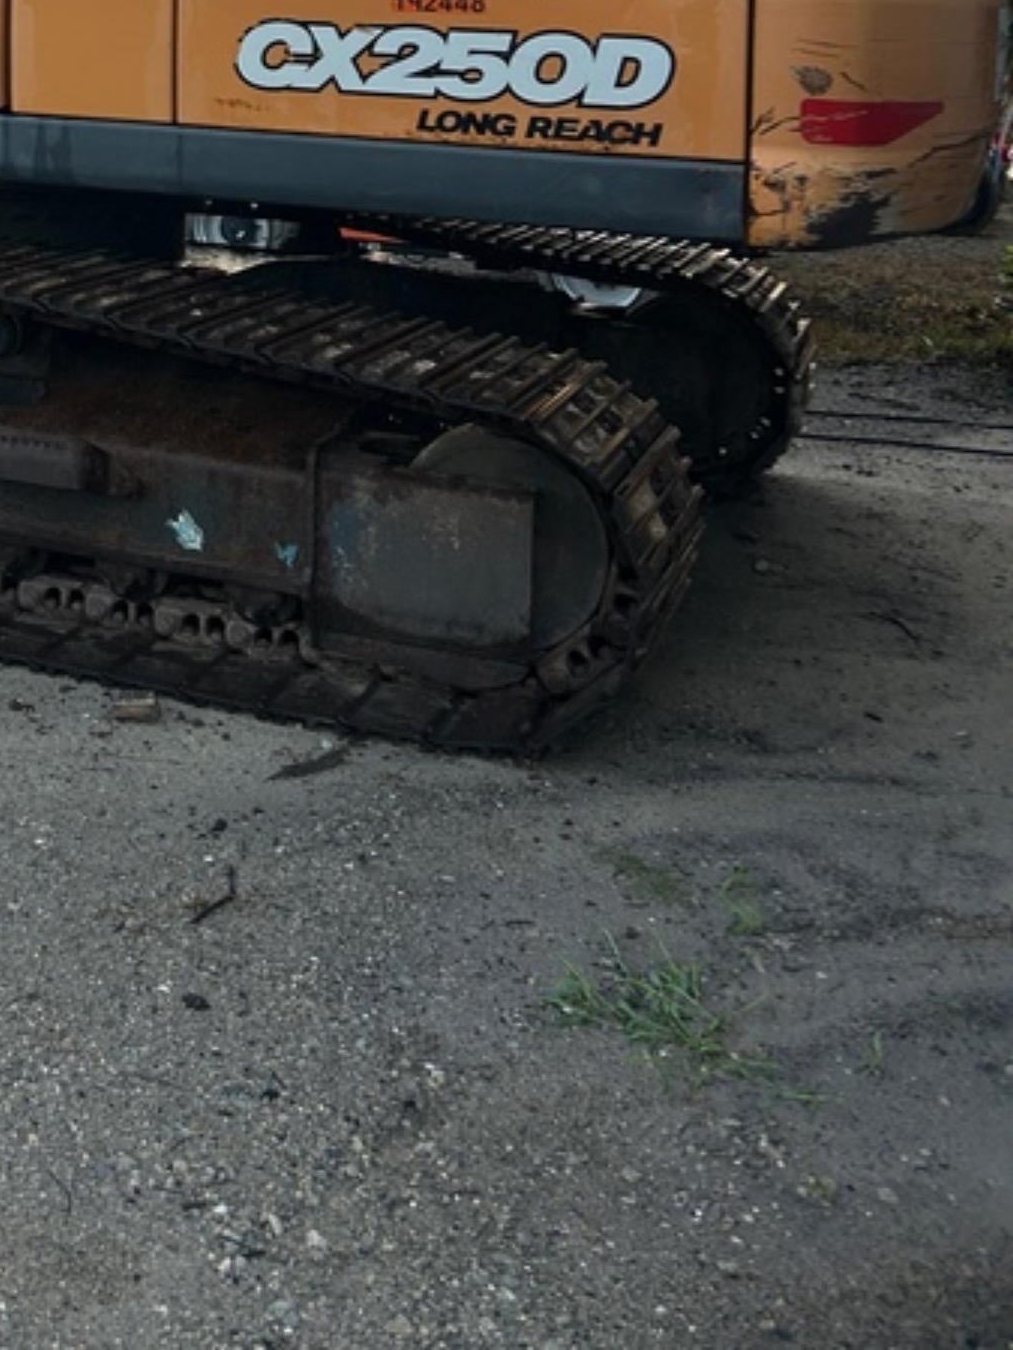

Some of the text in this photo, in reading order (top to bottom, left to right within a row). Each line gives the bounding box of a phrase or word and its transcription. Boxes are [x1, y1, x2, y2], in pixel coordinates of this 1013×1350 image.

[234, 17, 676, 110] CX250D
[415, 108, 664, 147] LONG REACH
